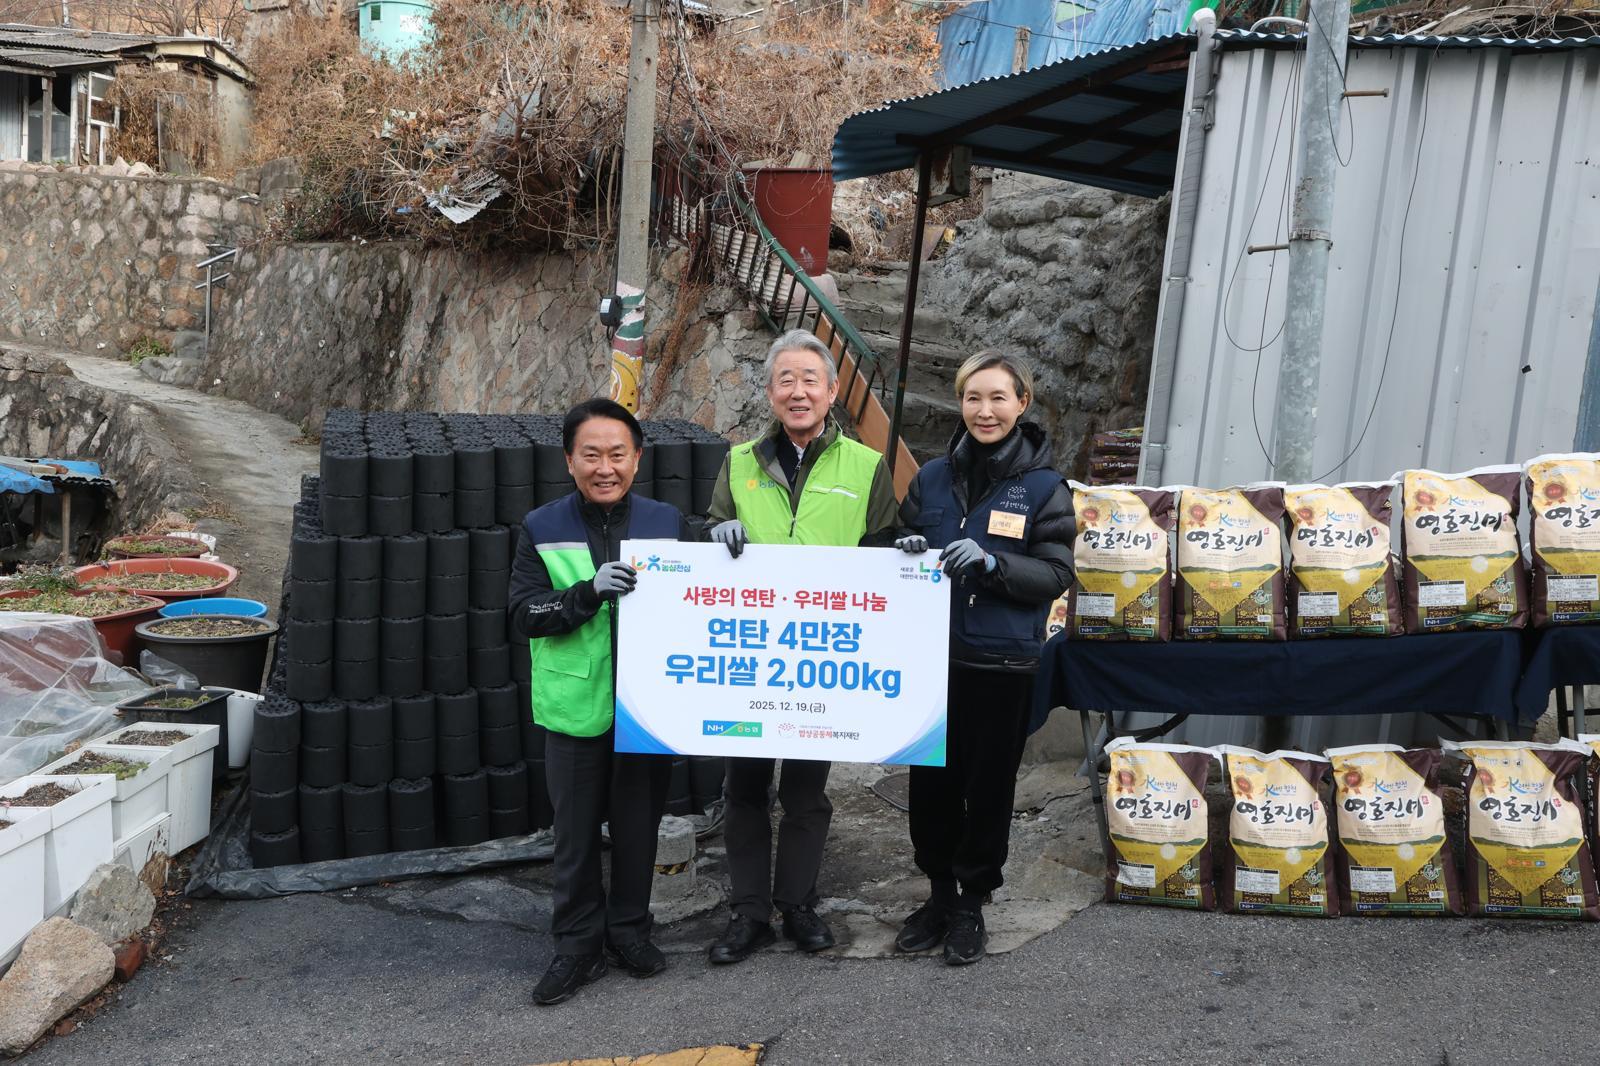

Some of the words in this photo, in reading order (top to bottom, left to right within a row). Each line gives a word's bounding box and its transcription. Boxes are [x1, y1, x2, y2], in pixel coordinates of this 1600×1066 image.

[1415, 509, 1502, 535] 영호진미
[1083, 527, 1151, 550] 영호진미
[1187, 528, 1262, 551] 영호진미
[1298, 524, 1373, 548] 영호진미
[683, 586, 735, 607] 사랑의
[741, 588, 777, 609] 연탄
[794, 590, 848, 611] 우리쌀
[852, 592, 888, 612] 나눔
[708, 618, 770, 649] 연탄
[778, 622, 863, 653] 4만장
[666, 655, 758, 686] 우리쌀
[767, 658, 902, 698] 2,000kg
[749, 700, 777, 711] 2025.
[780, 702, 793, 711] 12.
[796, 703, 826, 714] 19.(금)
[707, 724, 724, 732] NH
[1116, 793, 1191, 820] 영호진미
[1237, 800, 1314, 825] 영호진미
[1344, 796, 1423, 820] 영호진미
